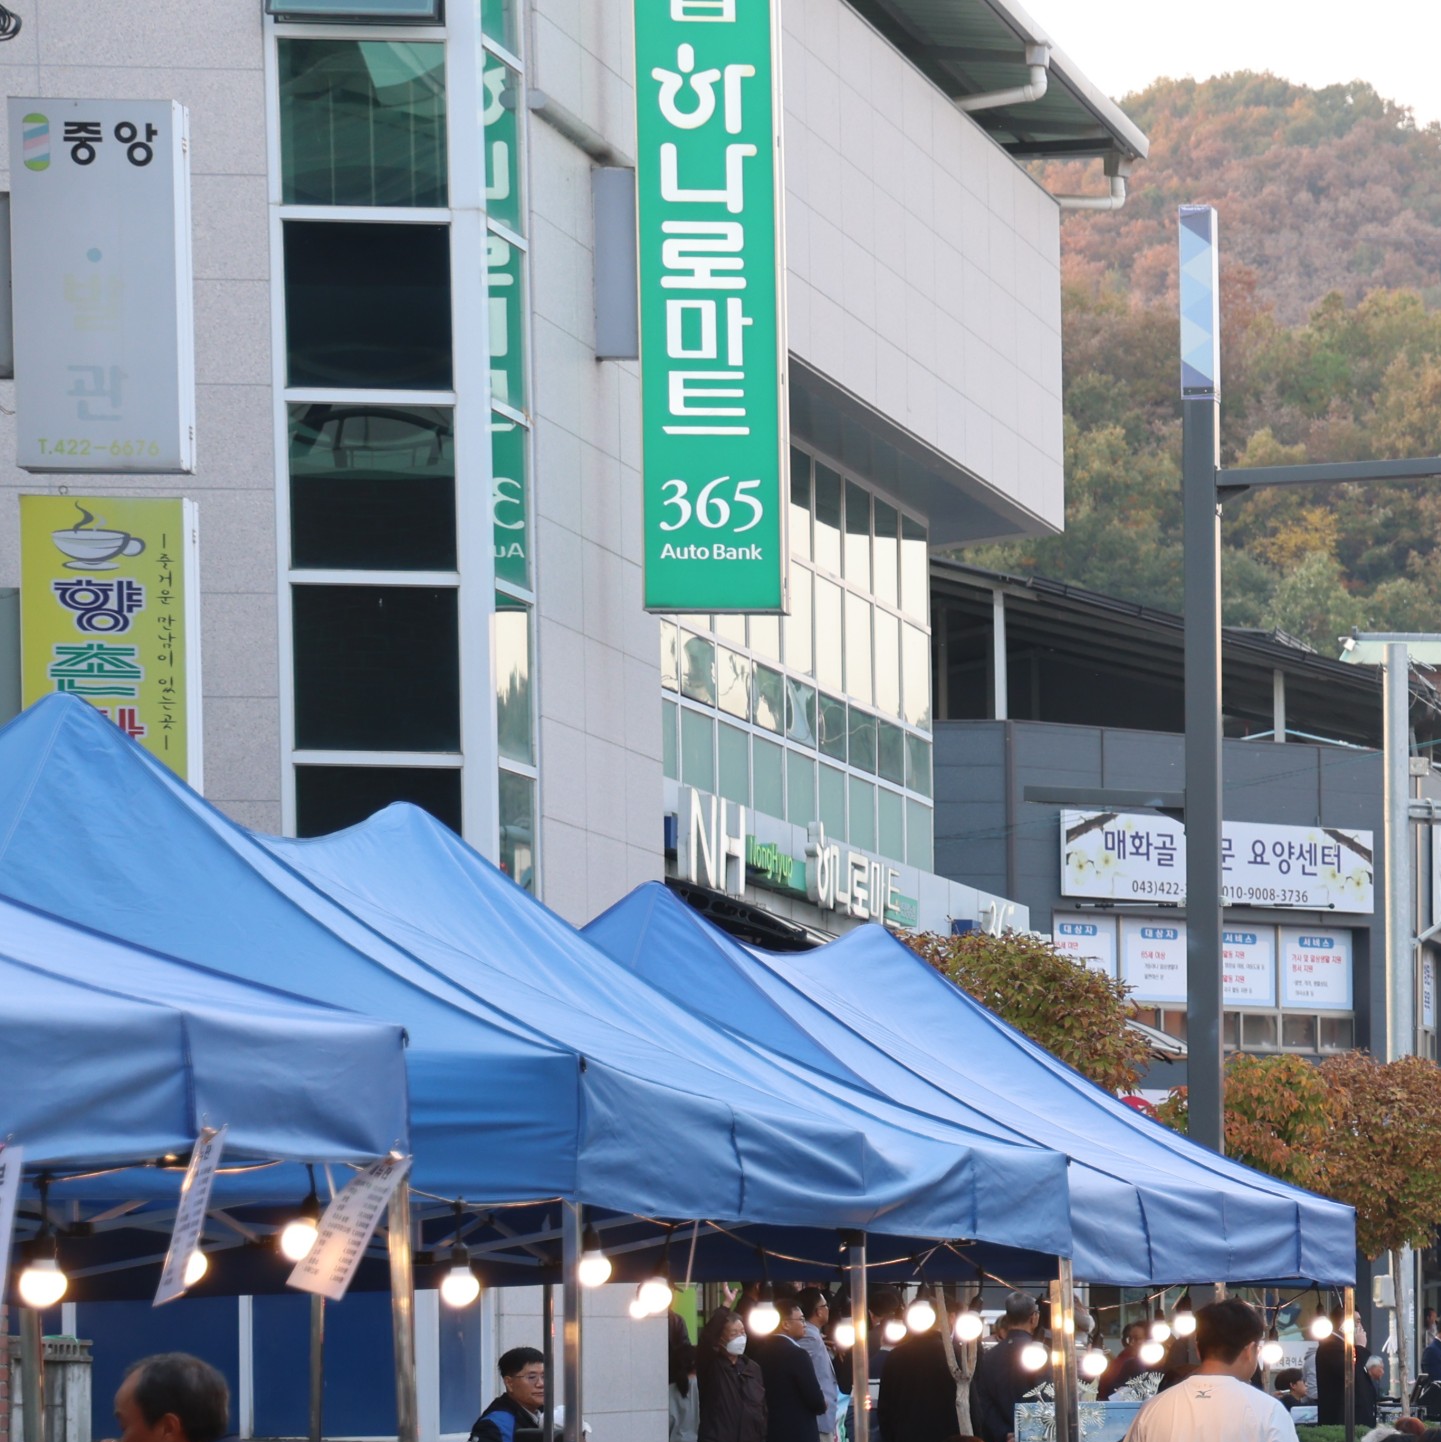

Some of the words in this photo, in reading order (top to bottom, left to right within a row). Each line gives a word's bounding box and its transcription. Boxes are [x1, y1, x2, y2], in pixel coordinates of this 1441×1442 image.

[63, 121, 158, 167] 중앙
[650, 43, 758, 435] 하나로마트
[659, 476, 764, 533] 365
[660, 543, 710, 560] Auto
[713, 542, 763, 560] Bank
[684, 786, 746, 897] NH
[1104, 830, 1177, 867] 매화골
[1248, 839, 1342, 877] 요양센터
[1132, 880, 1187, 896] 043)422-
[1303, 938, 1330, 947] 서비스
